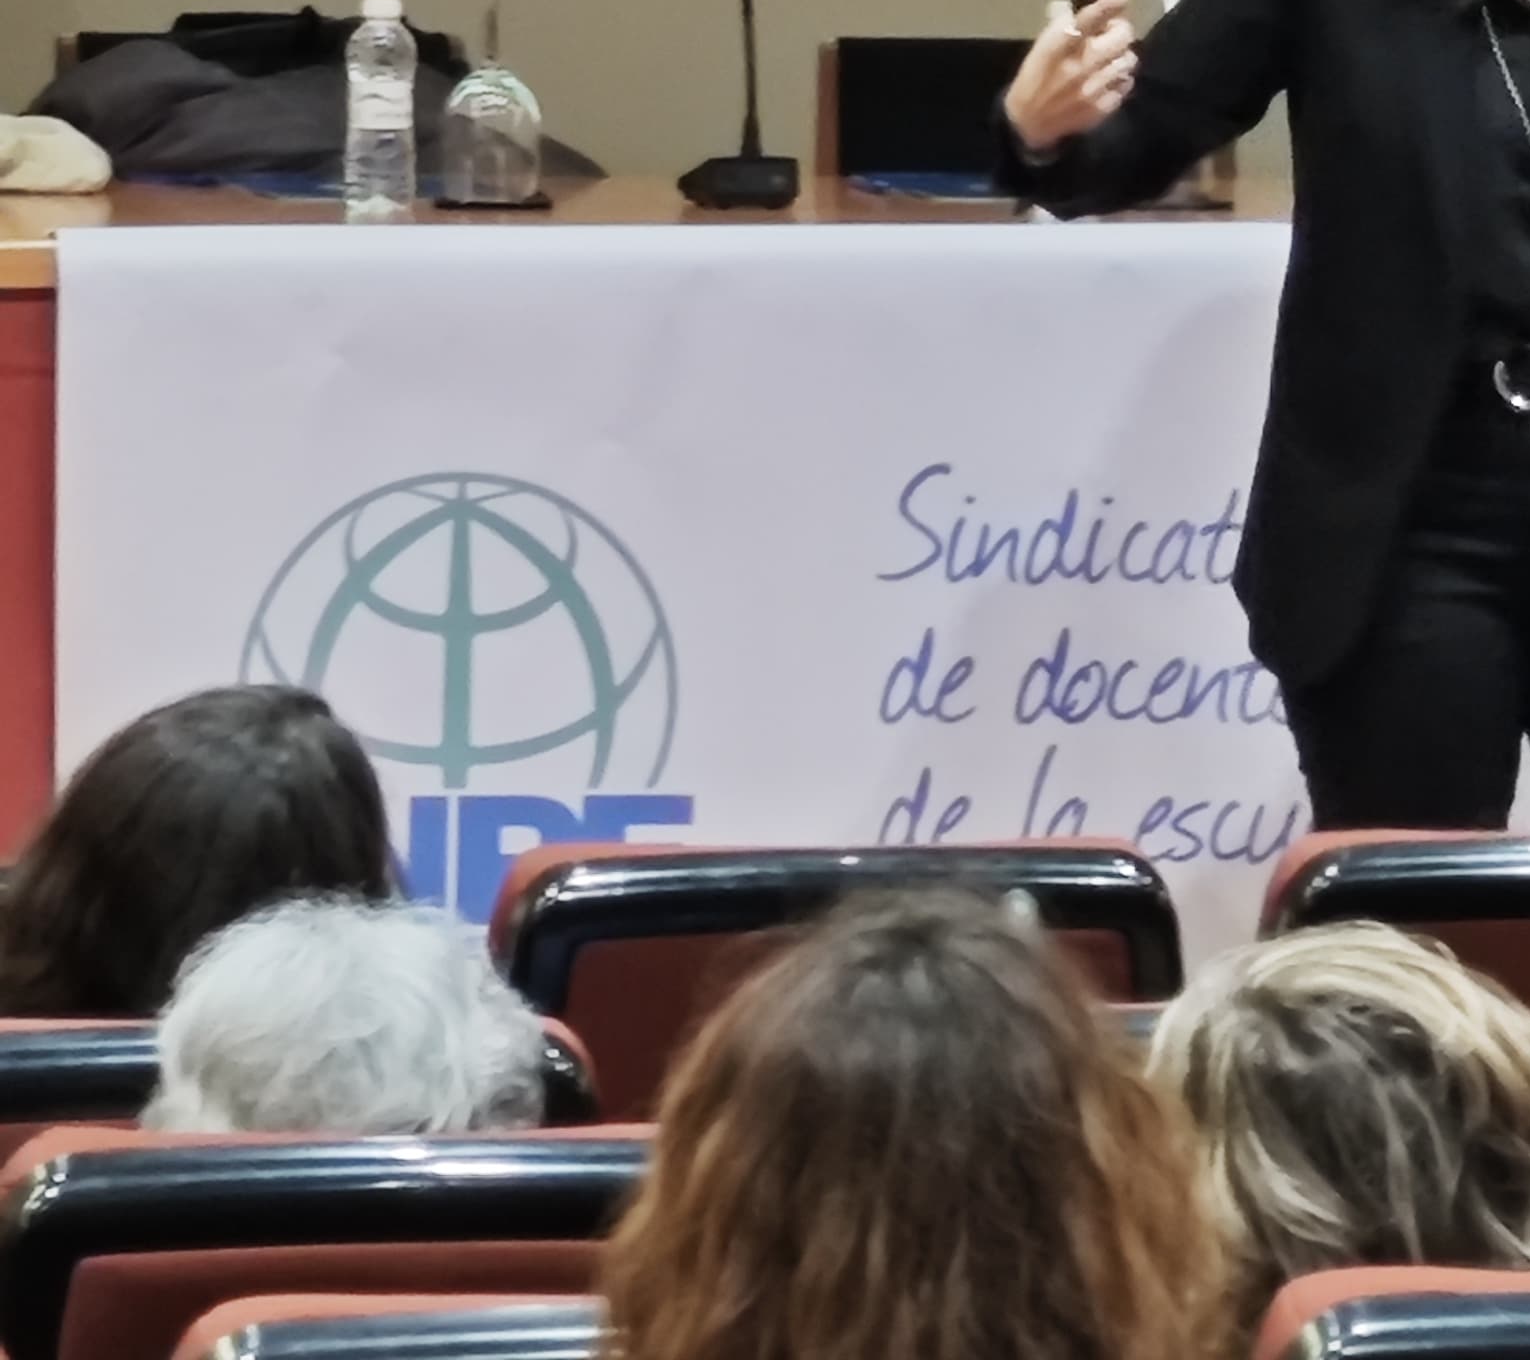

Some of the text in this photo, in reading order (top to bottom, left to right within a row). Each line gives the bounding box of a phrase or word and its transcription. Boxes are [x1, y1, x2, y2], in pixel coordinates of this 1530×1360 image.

[875, 463, 1244, 585] Sindicat
[878, 627, 1288, 727] de docent
[1135, 795, 1301, 865] escu
